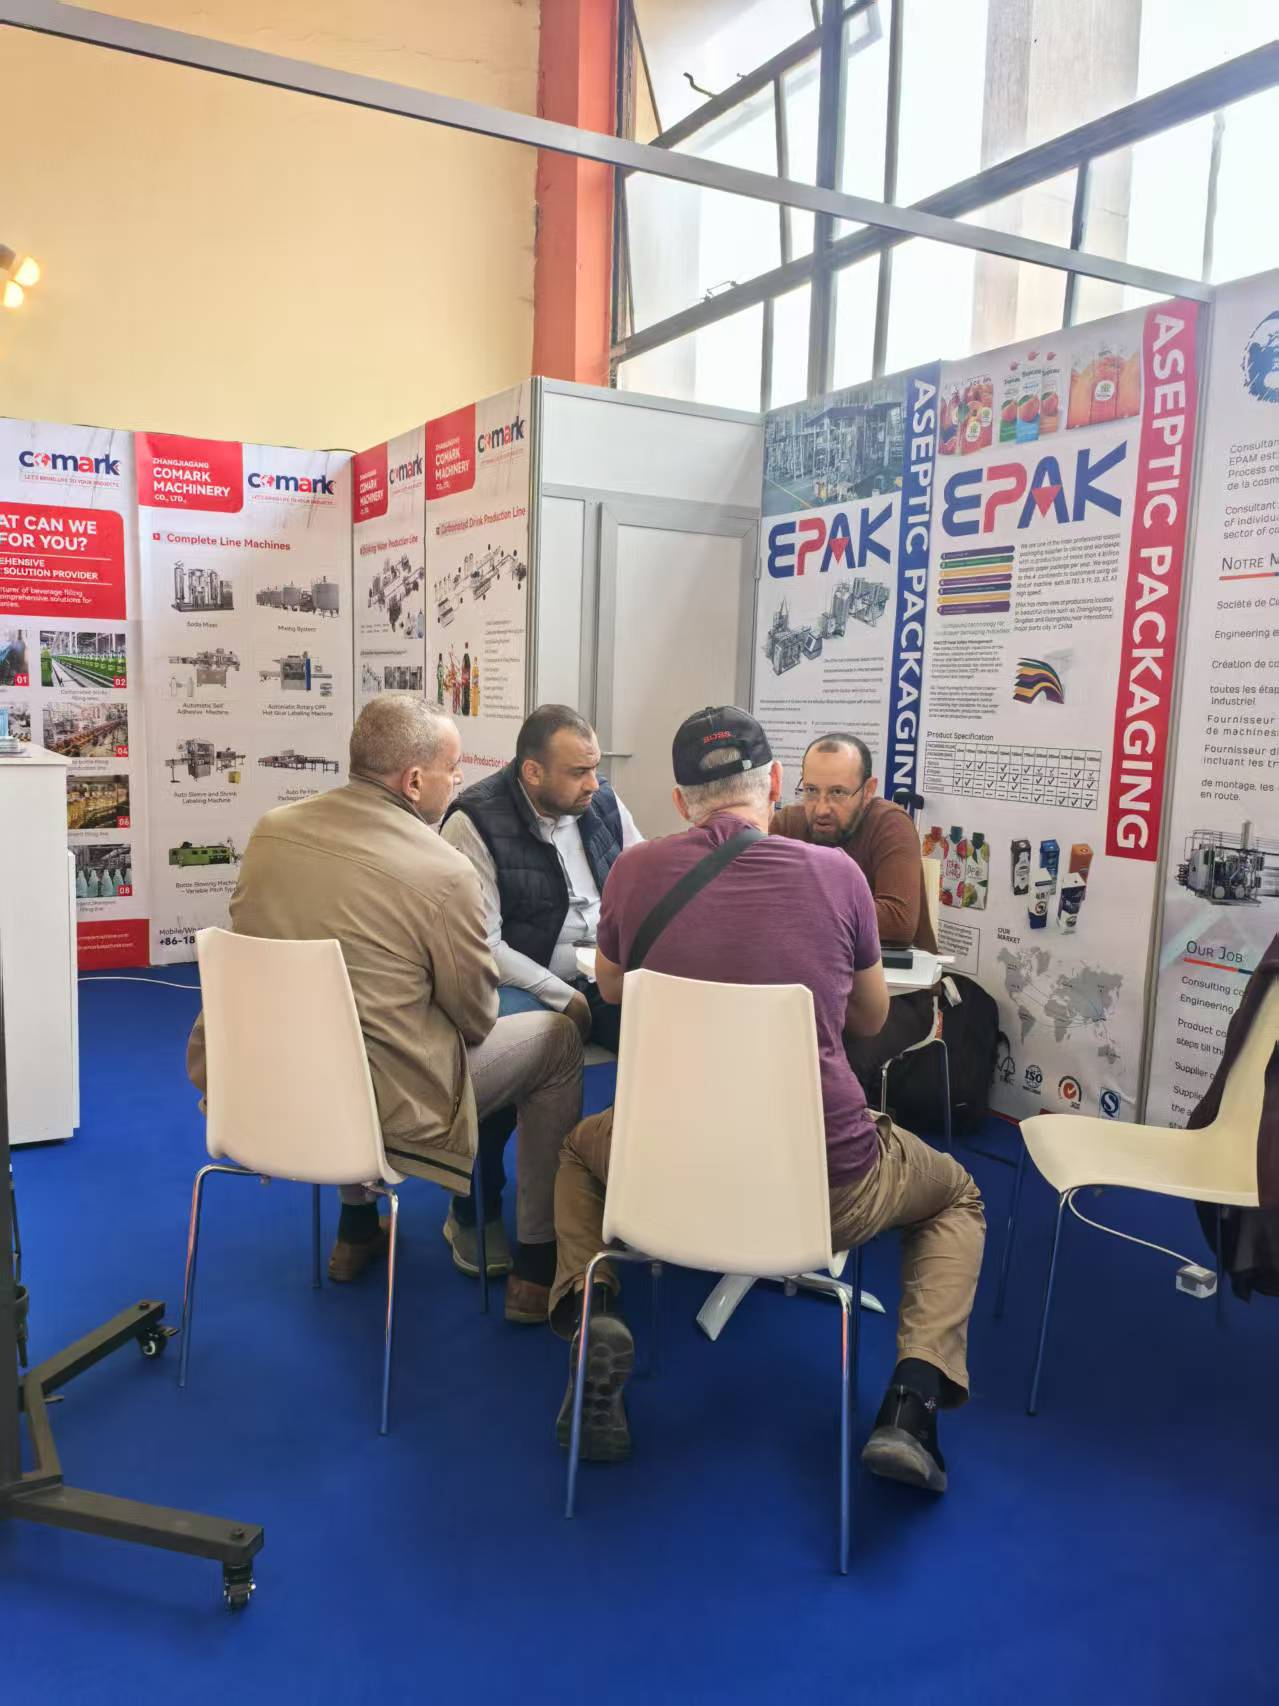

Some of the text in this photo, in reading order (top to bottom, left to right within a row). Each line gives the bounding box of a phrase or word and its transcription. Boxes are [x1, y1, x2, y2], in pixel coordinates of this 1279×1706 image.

[435, 447, 461, 467] COMARK
[1229, 454, 1258, 466] EPAM
[152, 458, 209, 469] ZHANGJIAGANG
[153, 467, 211, 483] COMARK
[435, 460, 470, 480] MACHINERY
[153, 480, 231, 498] MACHINERY
[942, 440, 1128, 537] EPAK
[1227, 482, 1239, 491] de
[1242, 480, 1250, 489] la
[1225, 501, 1276, 515] Consultant
[484, 510, 511, 525] Production
[513, 505, 526, 518] Line
[24, 515, 64, 532] CAN
[68, 519, 97, 535] WE
[1224, 519, 1234, 528] of
[1224, 526, 1266, 540] sector of
[39, 534, 88, 551] YOU?
[167, 533, 291, 551] Complete Line Machines
[768, 501, 893, 579] EPAK
[4, 567, 99, 580] SOLUTION PROVIDER
[1115, 313, 1186, 850] ASEPTIC PACKAGING
[892, 378, 936, 803] ASEPTIC PACKAGIN
[1217, 599, 1266, 610] Société de
[278, 625, 317, 633] Mixing System
[1214, 629, 1270, 640] Engineering
[1212, 660, 1252, 669] Création
[1254, 660, 1266, 669] de
[1210, 686, 1240, 694] toutes
[1242, 686, 1256, 694] les
[296, 704, 314, 712] Rotary
[1207, 715, 1273, 725] Fournisseur
[927, 731, 994, 741] Product Specification
[1206, 727, 1219, 736] de
[1204, 744, 1266, 755] Fournisseur
[474, 754, 502, 768] Production
[1203, 756, 1244, 766] incluant
[1248, 759, 1264, 768] les
[1201, 779, 1213, 787] de
[1259, 783, 1274, 792] les
[1200, 791, 1212, 799] en
[119, 818, 130, 826] 06
[225, 886, 236, 895] Typ
[159, 927, 204, 936] Mobile/Wh
[997, 927, 1010, 935] OUR
[997, 934, 1021, 944] MARKET
[1181, 976, 1231, 996] Consulting
[1180, 993, 1234, 1015] Engineering
[1176, 1037, 1199, 1050] steps
[1201, 1042, 1211, 1053] till
[1175, 1061, 1208, 1077] Supplier
[1024, 1069, 1043, 1083] ISO
[1171, 1103, 1186, 1114] the
